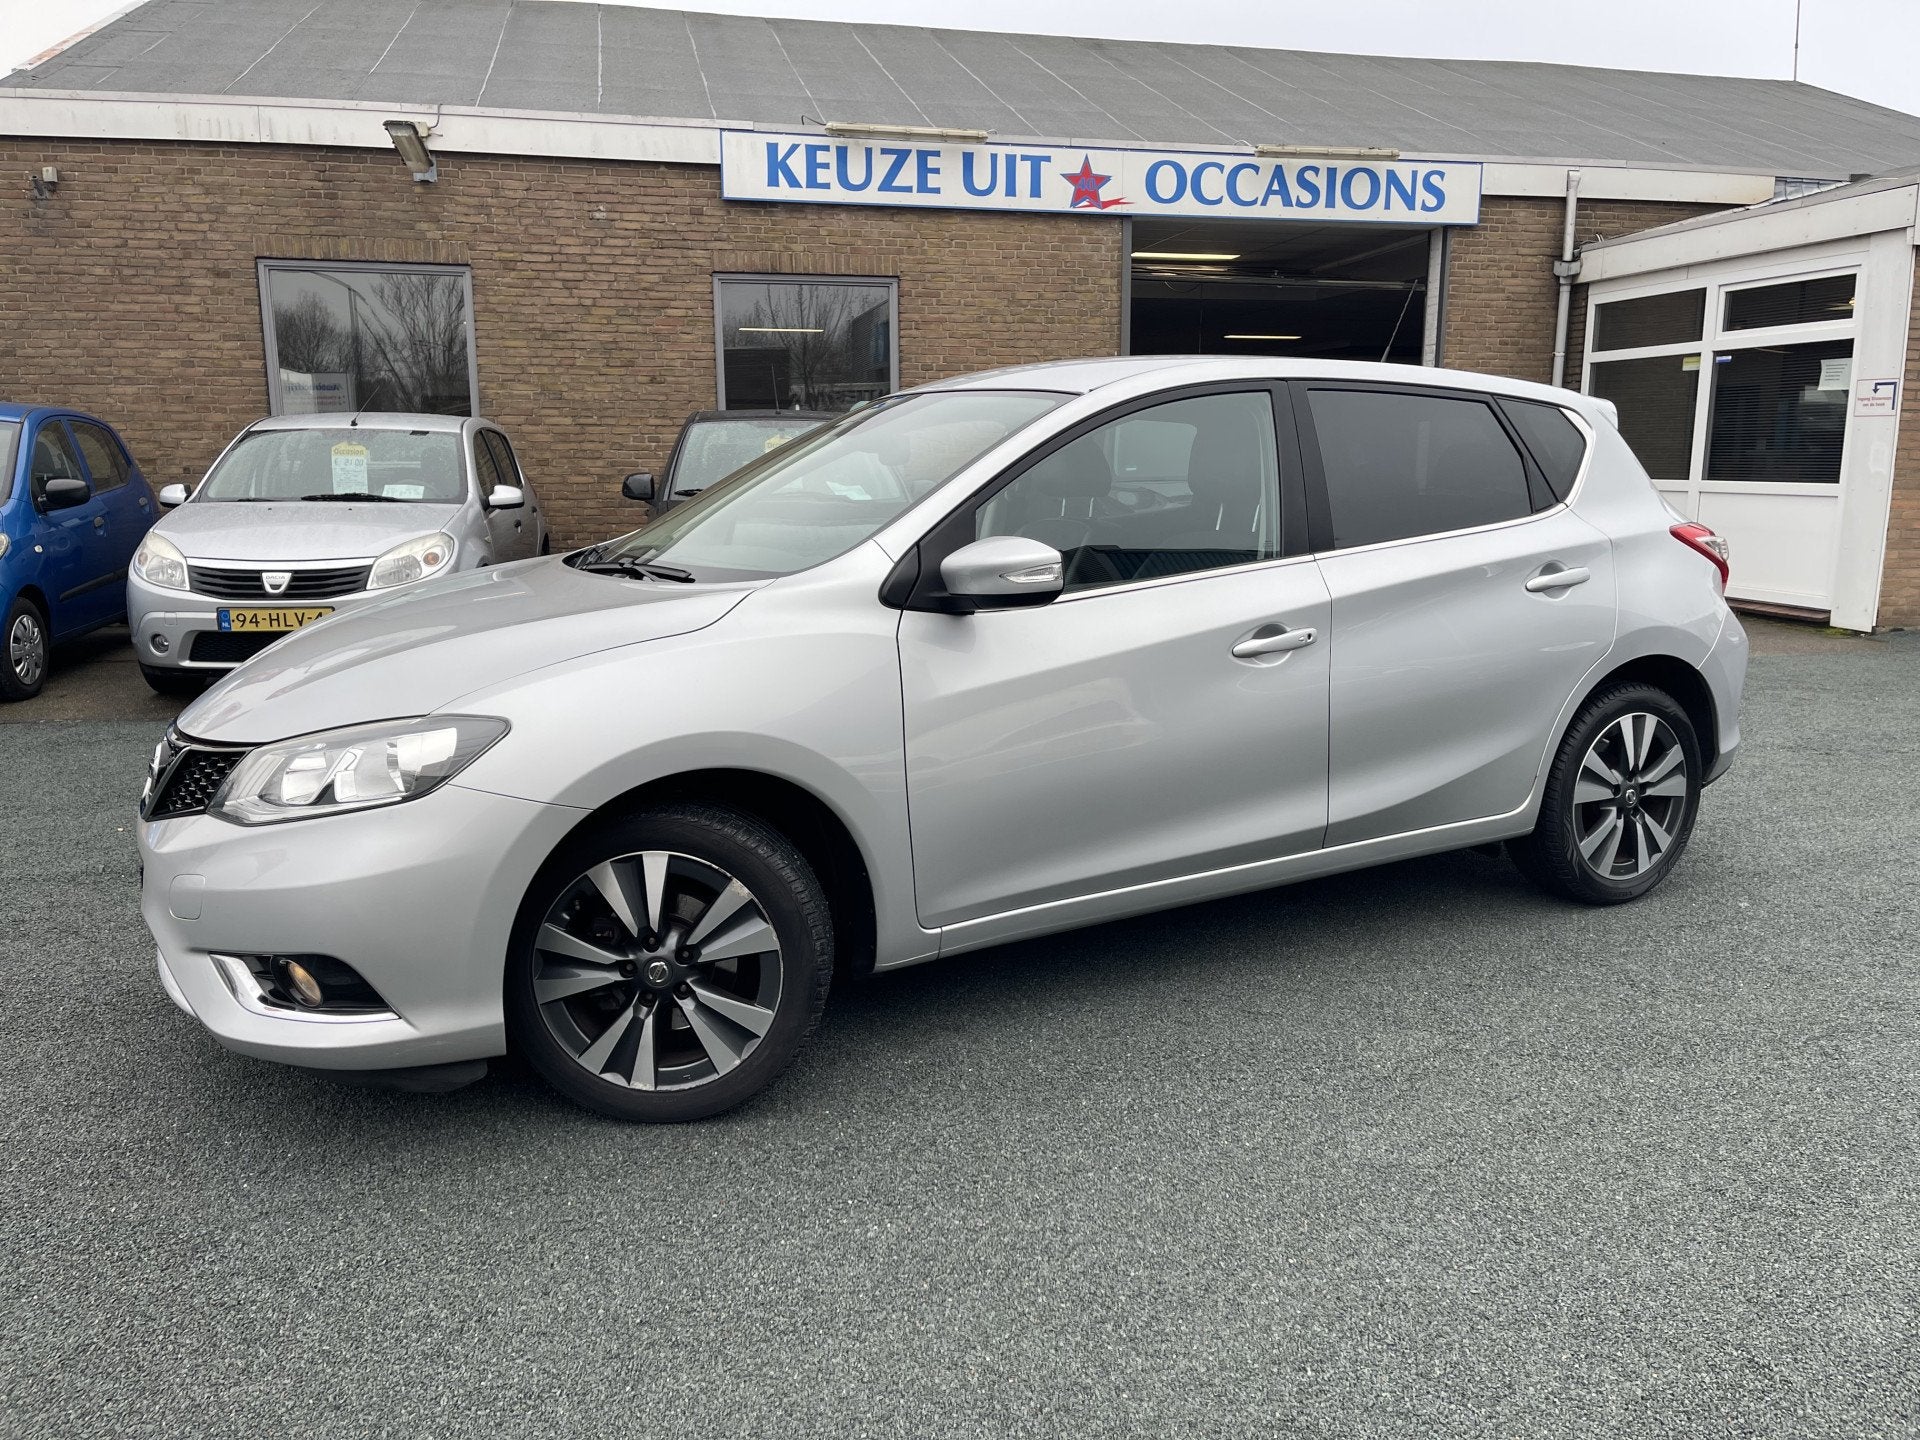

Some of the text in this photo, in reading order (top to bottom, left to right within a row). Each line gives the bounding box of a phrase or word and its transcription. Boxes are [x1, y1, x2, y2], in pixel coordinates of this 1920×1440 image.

[766, 142, 1446, 213] KEUZE UIT OCCASIONS
[333, 447, 365, 455] Occasion
